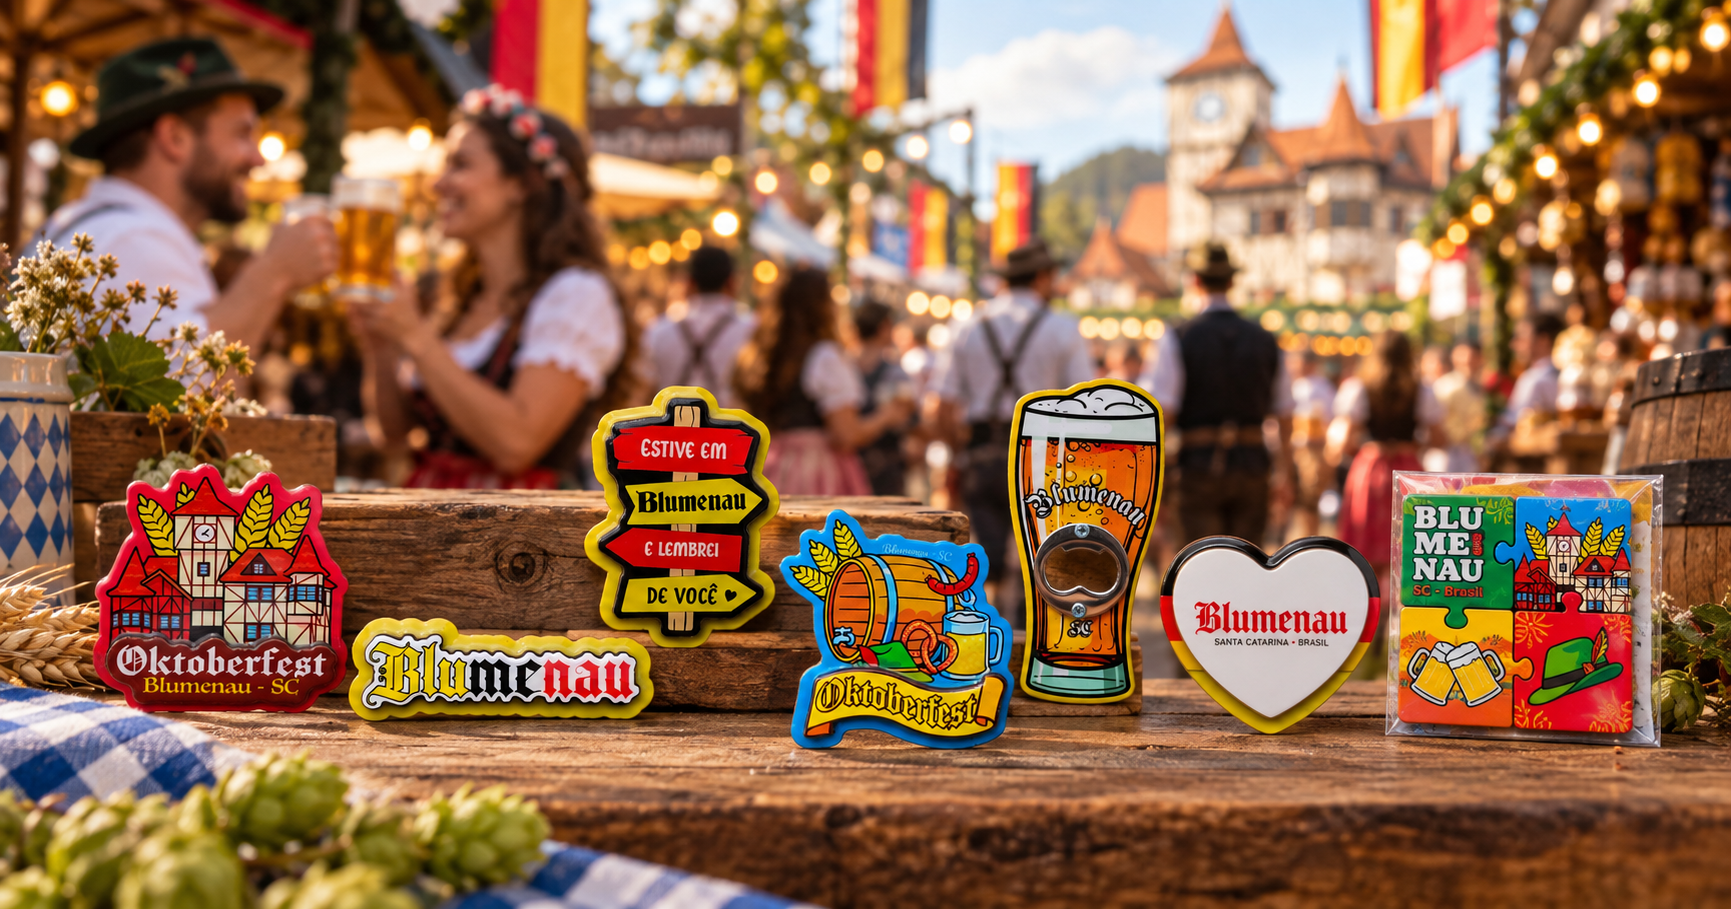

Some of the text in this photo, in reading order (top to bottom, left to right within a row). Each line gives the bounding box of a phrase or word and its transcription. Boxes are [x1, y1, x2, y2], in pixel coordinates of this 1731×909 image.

[640, 438, 727, 460] ESTIVE EM
[635, 490, 747, 513] Blumenau
[1023, 482, 1147, 525] Blumenau
[1413, 505, 1484, 530] BLU
[644, 541, 719, 557] E LEMBREI
[1413, 531, 1470, 555] ME
[938, 550, 953, 562] SC
[1412, 557, 1484, 582] NAU
[647, 583, 718, 605] DE VOCÊ
[1413, 584, 1432, 596] SC
[1444, 585, 1484, 598] Brasil
[1067, 620, 1093, 638] SC
[1194, 600, 1349, 635] Blumenau
[1214, 638, 1243, 646] SANTA
[1245, 638, 1289, 646] CATARINA
[1298, 639, 1329, 647] BRASIL
[117, 645, 327, 677] Oktoberfest
[366, 641, 634, 705] Blumenau
[143, 677, 252, 694] Blumenau
[271, 678, 300, 696] SC
[815, 676, 978, 730] Oktoberfest
